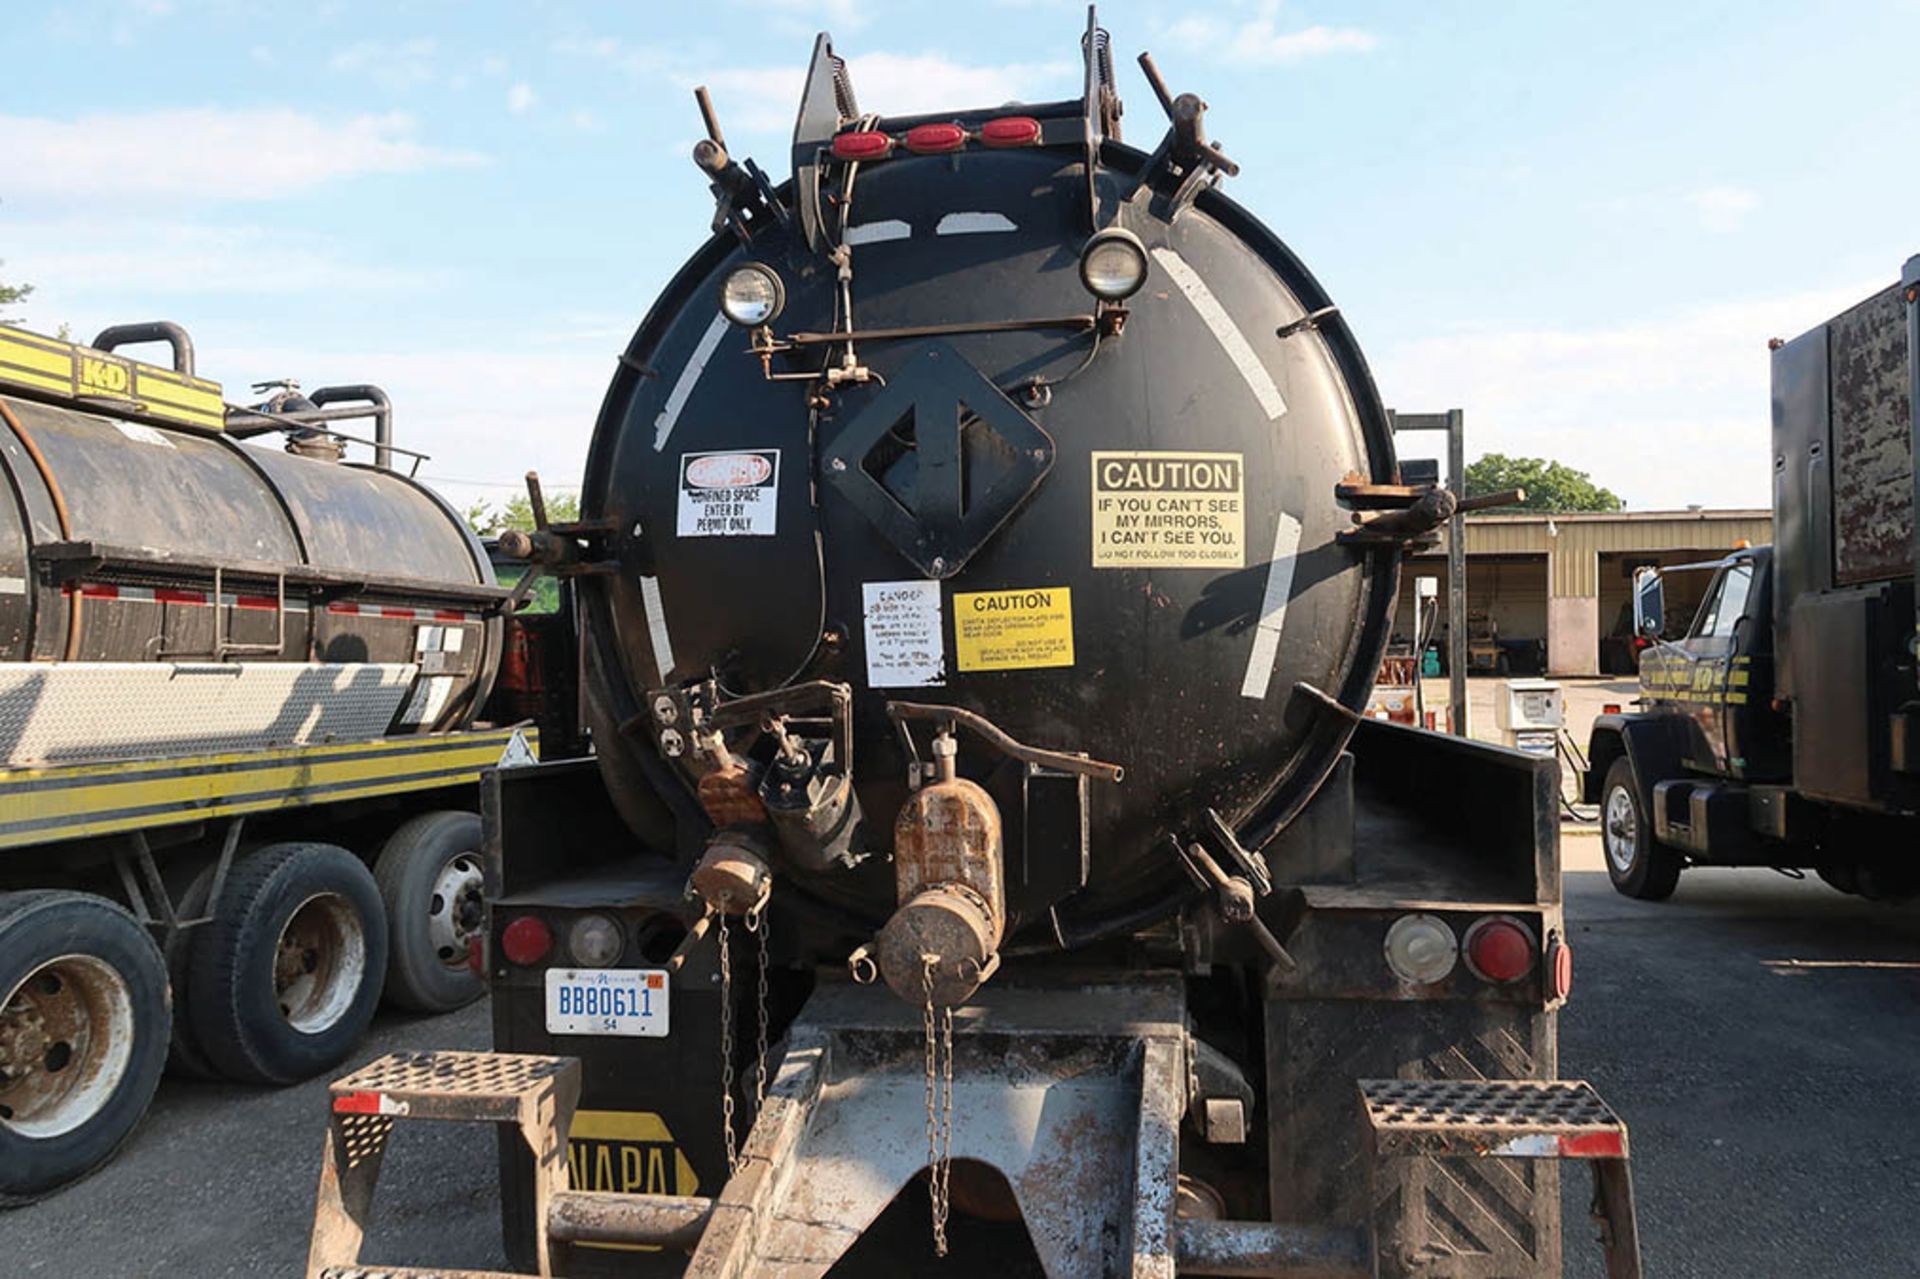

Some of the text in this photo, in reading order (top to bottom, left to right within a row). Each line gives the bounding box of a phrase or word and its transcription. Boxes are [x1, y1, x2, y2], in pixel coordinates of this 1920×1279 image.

[1103, 461, 1233, 489] CAUTION
[704, 504, 744, 517] ENTER BY
[1098, 499, 1113, 512] IF
[1117, 499, 1151, 512] YOU
[1208, 499, 1239, 512] SEE
[697, 518, 751, 531] PERMIT ONLY
[1115, 515, 1140, 527] MY
[1102, 531, 1106, 544] I
[1110, 531, 1158, 544] CAN'T
[1164, 531, 1195, 544] SEE
[1115, 551, 1134, 559] NOT
[1136, 551, 1175, 559] FOLLOW
[1178, 551, 1197, 559] TOO
[973, 593, 1051, 611] CAUTION
[559, 986, 653, 1017] BB80611
